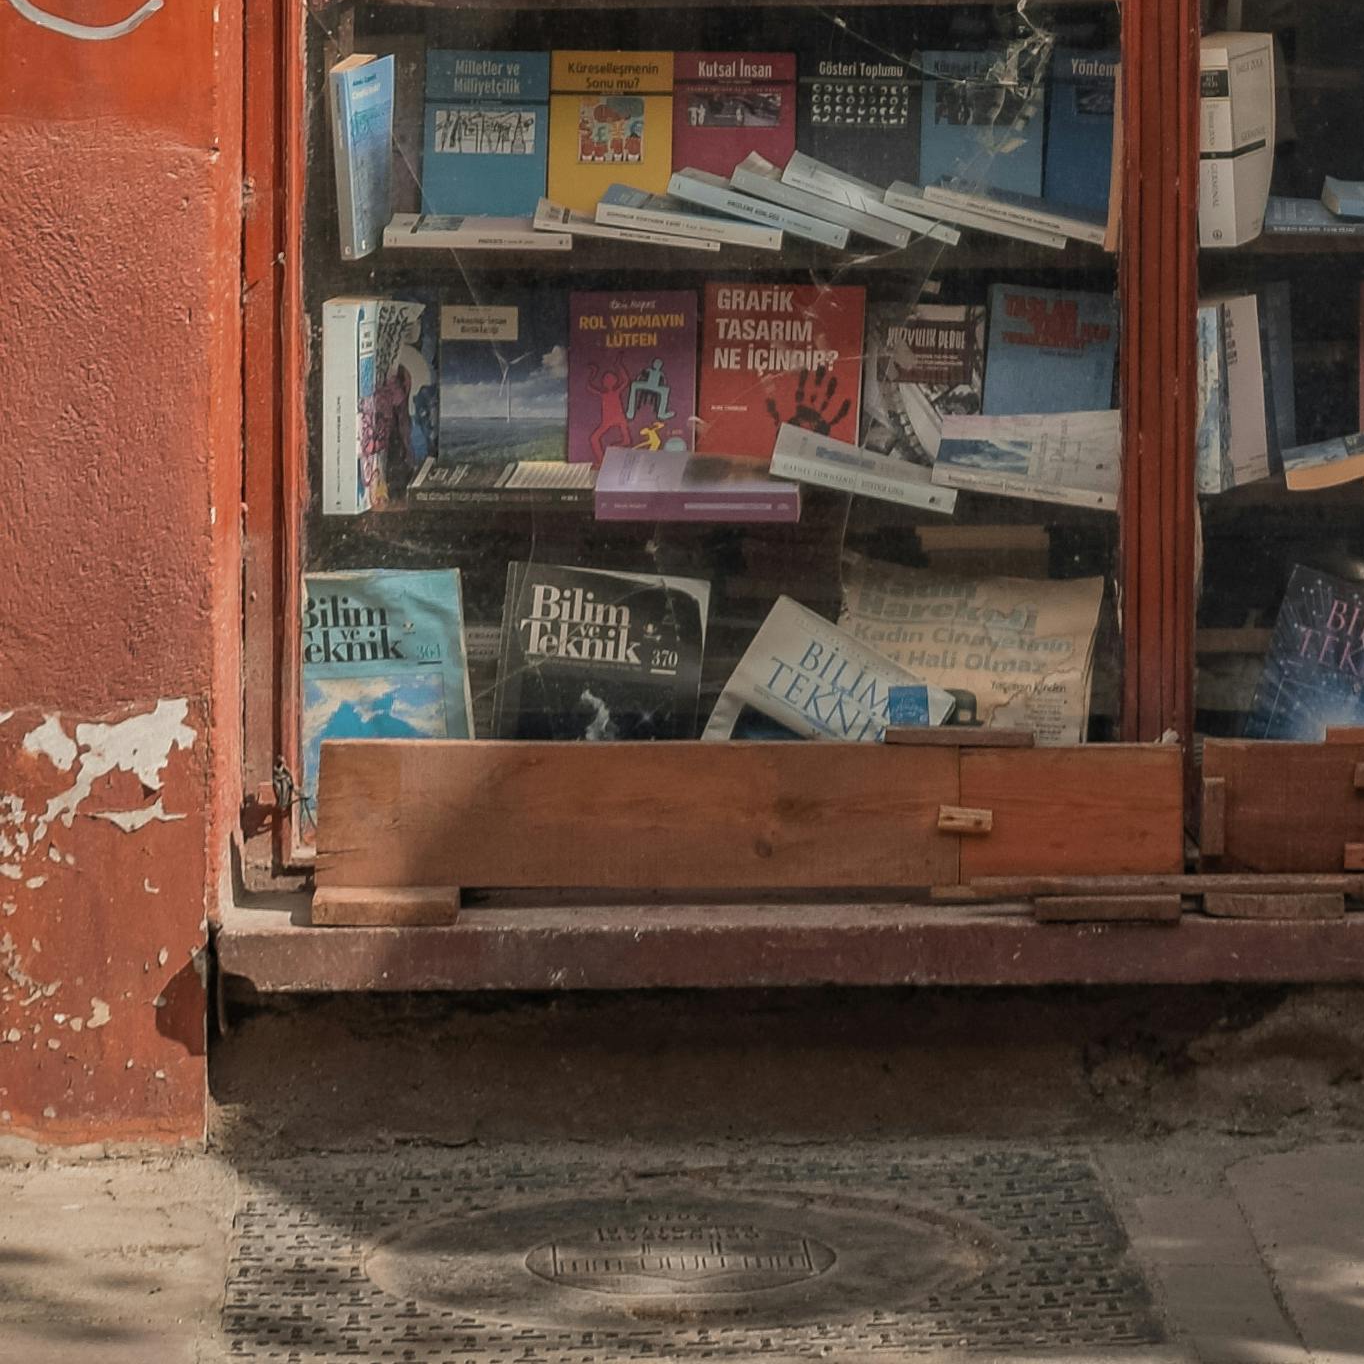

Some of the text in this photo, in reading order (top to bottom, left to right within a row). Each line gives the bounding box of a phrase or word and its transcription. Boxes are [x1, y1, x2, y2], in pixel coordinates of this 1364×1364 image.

[455, 59, 520, 77] Milletler ve
[568, 60, 659, 78] Küreselleşmenin
[697, 58, 772, 78] Kutsal İnsan
[818, 60, 904, 80] Gösteri Toplumu
[453, 76, 521, 97] Milliyetçilik
[586, 76, 640, 90] Sonu mu?
[716, 284, 794, 313] GRAFİK
[579, 313, 685, 331] ROL YAPMAYIN
[715, 317, 813, 343] TASARIM
[605, 330, 658, 349] LÜTFEN
[714, 344, 839, 376] NE İÇİNDİR?
[528, 583, 632, 627] Bilim
[341, 629, 361, 641] ve
[579, 624, 601, 636] ve
[519, 617, 642, 665] Teknik
[651, 648, 680, 669] 370
[906, 649, 957, 670] Hali
